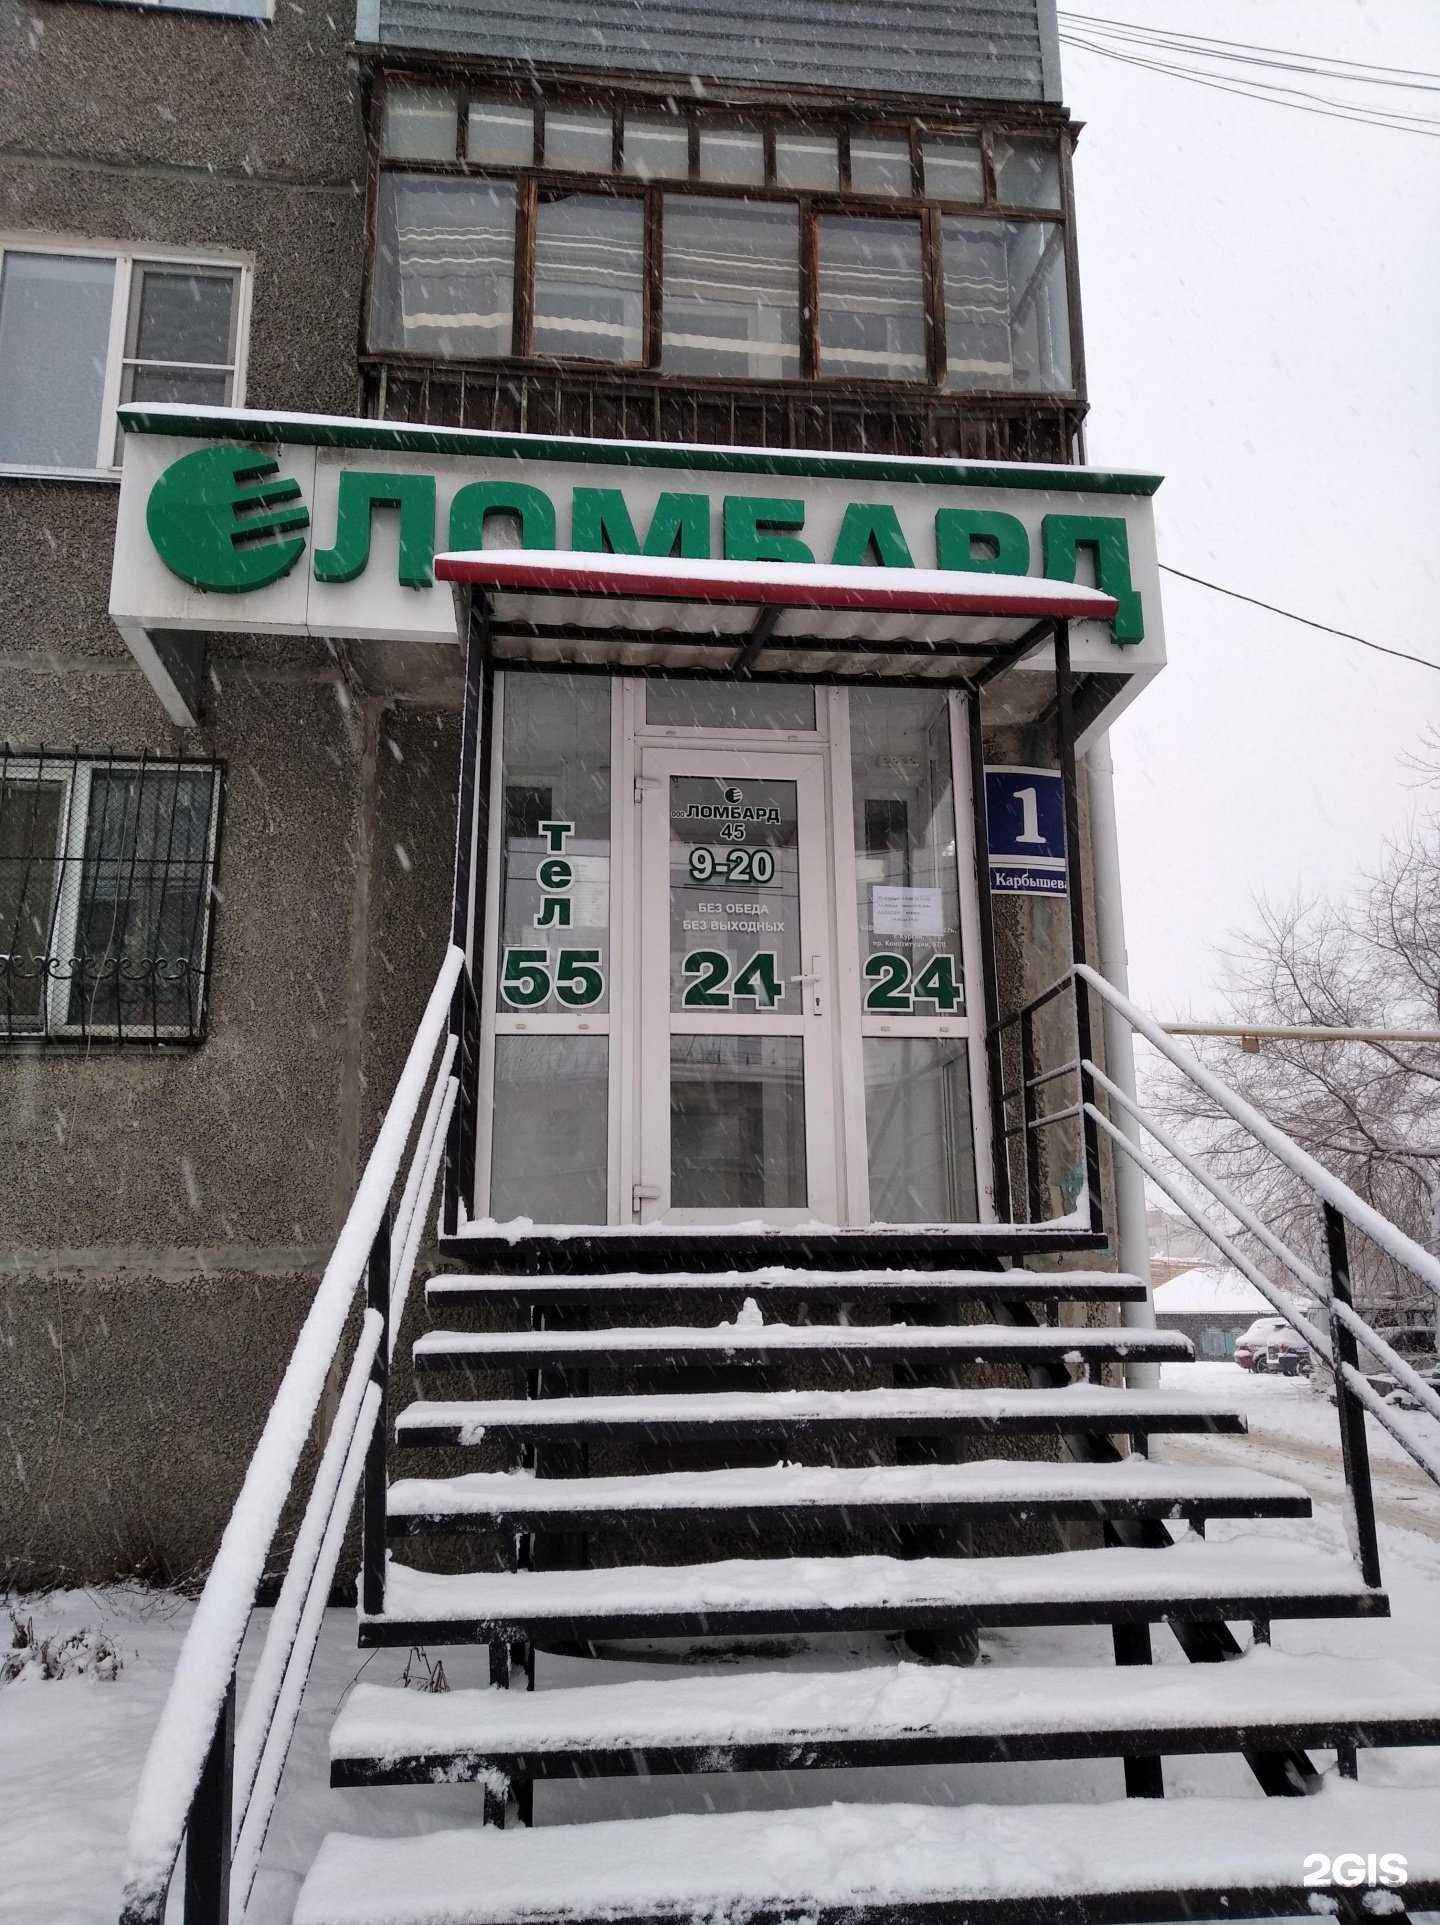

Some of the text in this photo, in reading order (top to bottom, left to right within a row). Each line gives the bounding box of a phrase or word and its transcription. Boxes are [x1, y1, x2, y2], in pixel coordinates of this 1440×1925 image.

[686, 804, 781, 825] ЛОМБАРД
[1013, 787, 1047, 844] 1
[720, 822, 746, 841] 45
[689, 848, 775, 883] 9-20
[698, 903, 769, 916] БЕЗ ОБЕДА
[682, 920, 785, 933] БЕЗ ВЫХОДНЫХ
[501, 947, 963, 1012] 55 24 24
